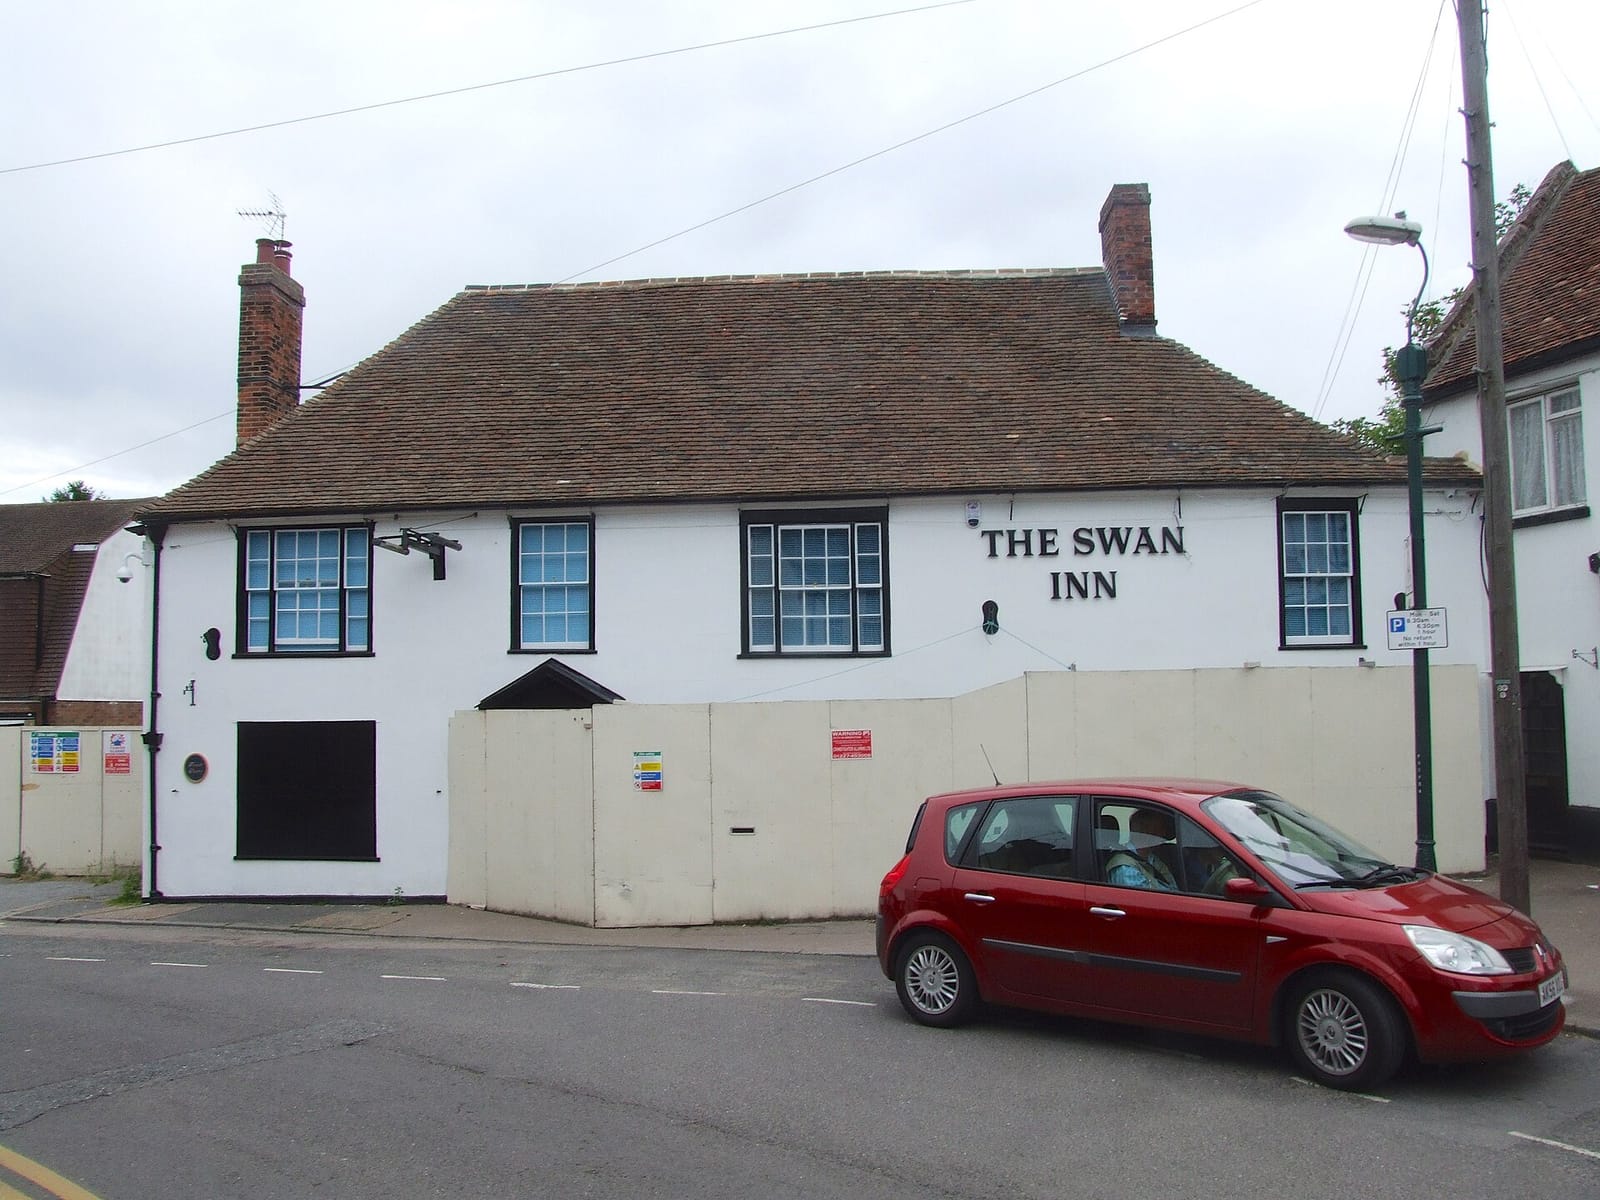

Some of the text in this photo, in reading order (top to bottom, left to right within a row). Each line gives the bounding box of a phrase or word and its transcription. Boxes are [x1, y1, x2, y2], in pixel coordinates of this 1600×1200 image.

[981, 526, 1186, 558] THE SWAN
[1050, 571, 1118, 600] INN
[1393, 619, 1403, 632] P
